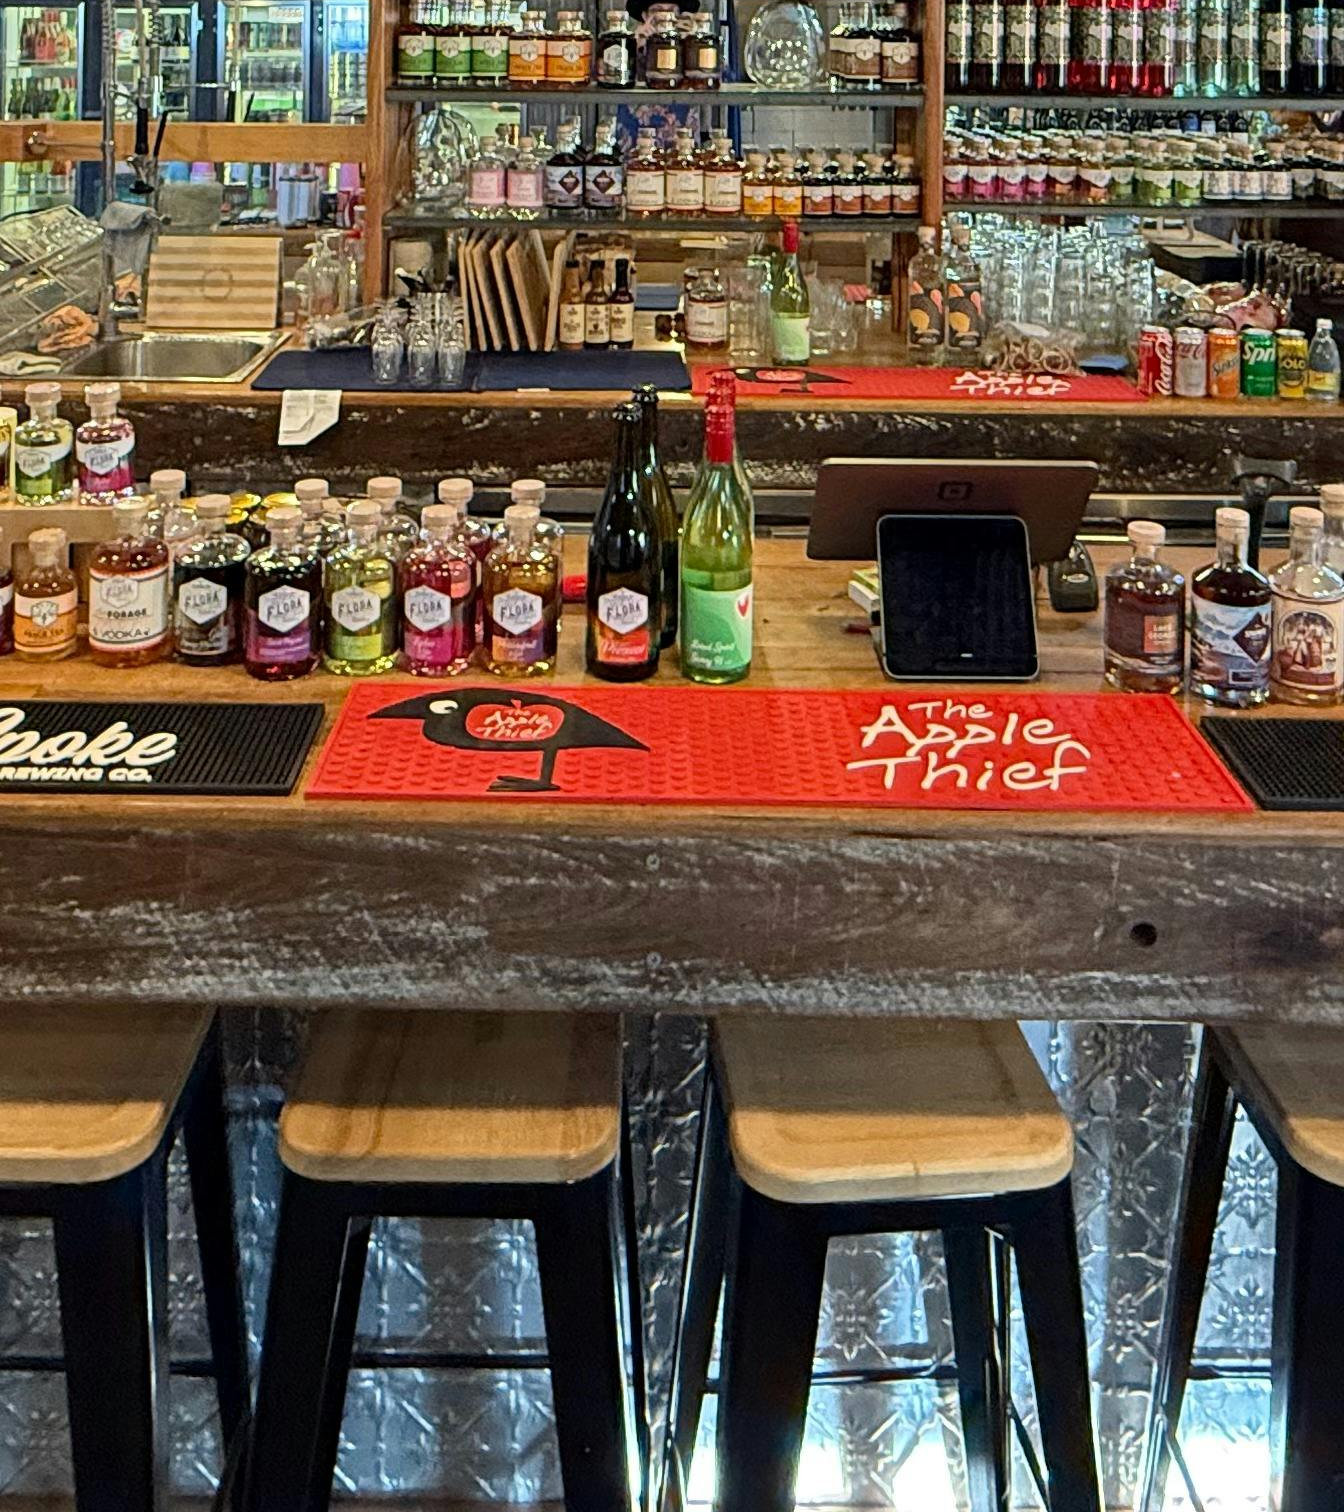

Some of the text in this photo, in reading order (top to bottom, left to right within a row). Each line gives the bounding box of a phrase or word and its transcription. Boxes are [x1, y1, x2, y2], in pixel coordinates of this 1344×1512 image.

[267, 598, 304, 621] FLORA
[410, 599, 443, 618] FLORA
[501, 601, 535, 622] FLORA
[607, 601, 641, 622] FLORA
[483, 710, 550, 729] Apple
[908, 698, 994, 720] The
[475, 721, 553, 739] Thief
[860, 704, 1072, 759] Apple
[846, 739, 1091, 791] Thief
